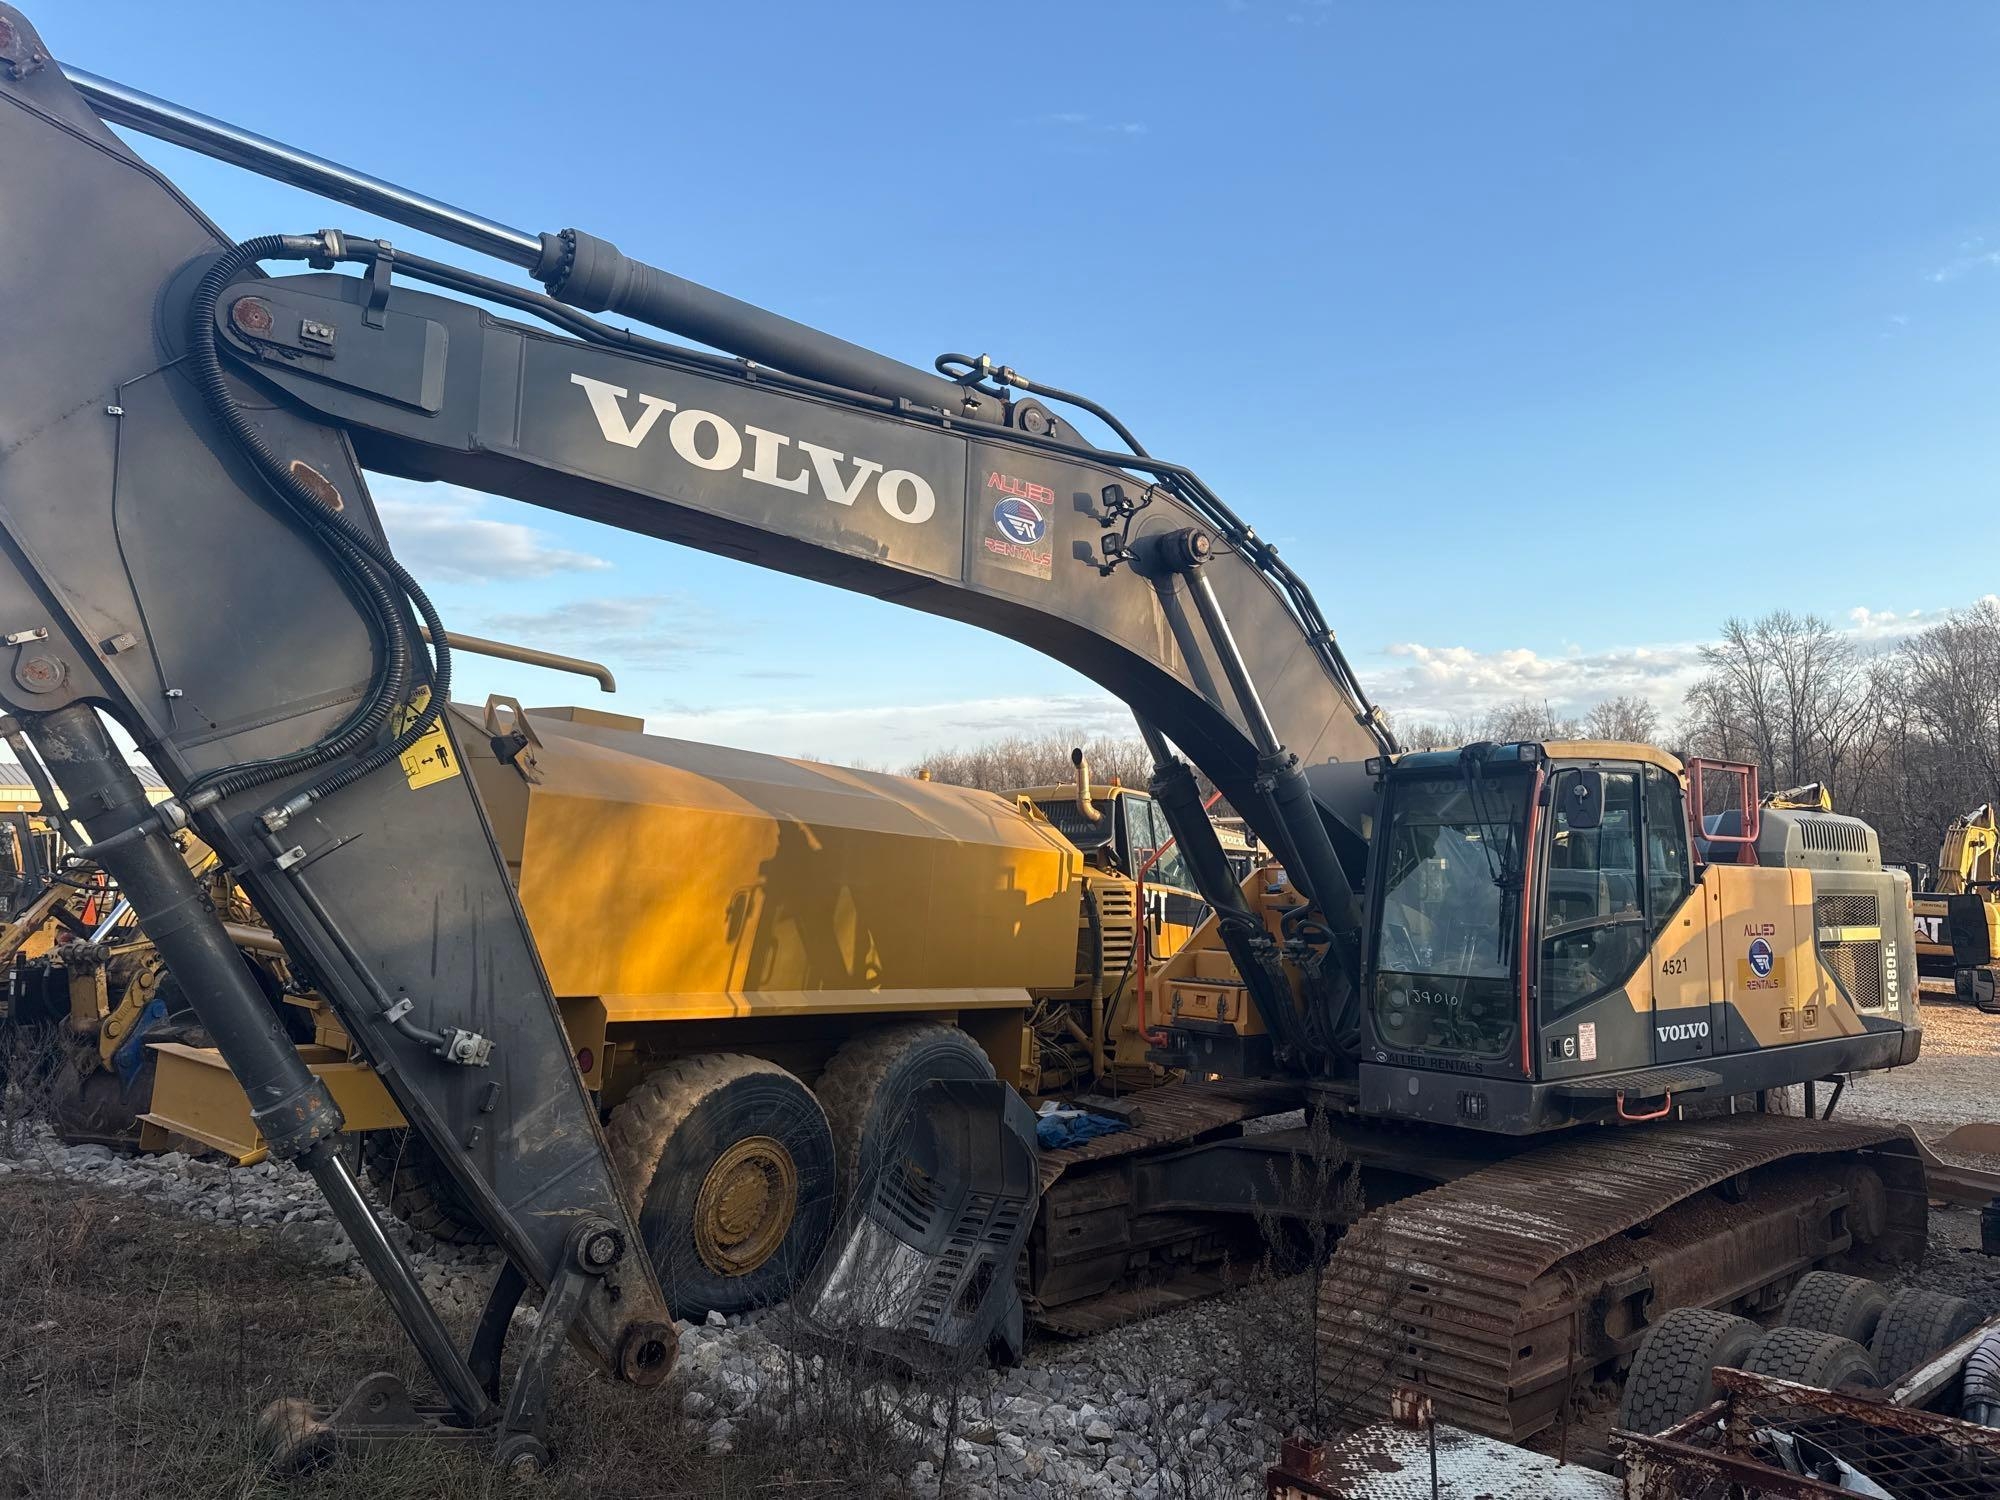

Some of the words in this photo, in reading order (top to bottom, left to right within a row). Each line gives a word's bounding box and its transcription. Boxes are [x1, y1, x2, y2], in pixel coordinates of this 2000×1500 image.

[570, 373, 936, 524] VOLVO
[987, 471, 1055, 505] ALLIED
[984, 537, 1052, 566] RENTALS
[1219, 833, 1245, 846] VOLV
[1744, 923, 1775, 936] ALLIED
[1914, 916, 1943, 943] AT
[1662, 958, 1688, 976] 4521
[1746, 979, 1779, 991] RENTALS
[1657, 1021, 1709, 1043] VOLVO
[1389, 1053, 1425, 1067] ALLIED
[1431, 1057, 1483, 1073] RENTALS
